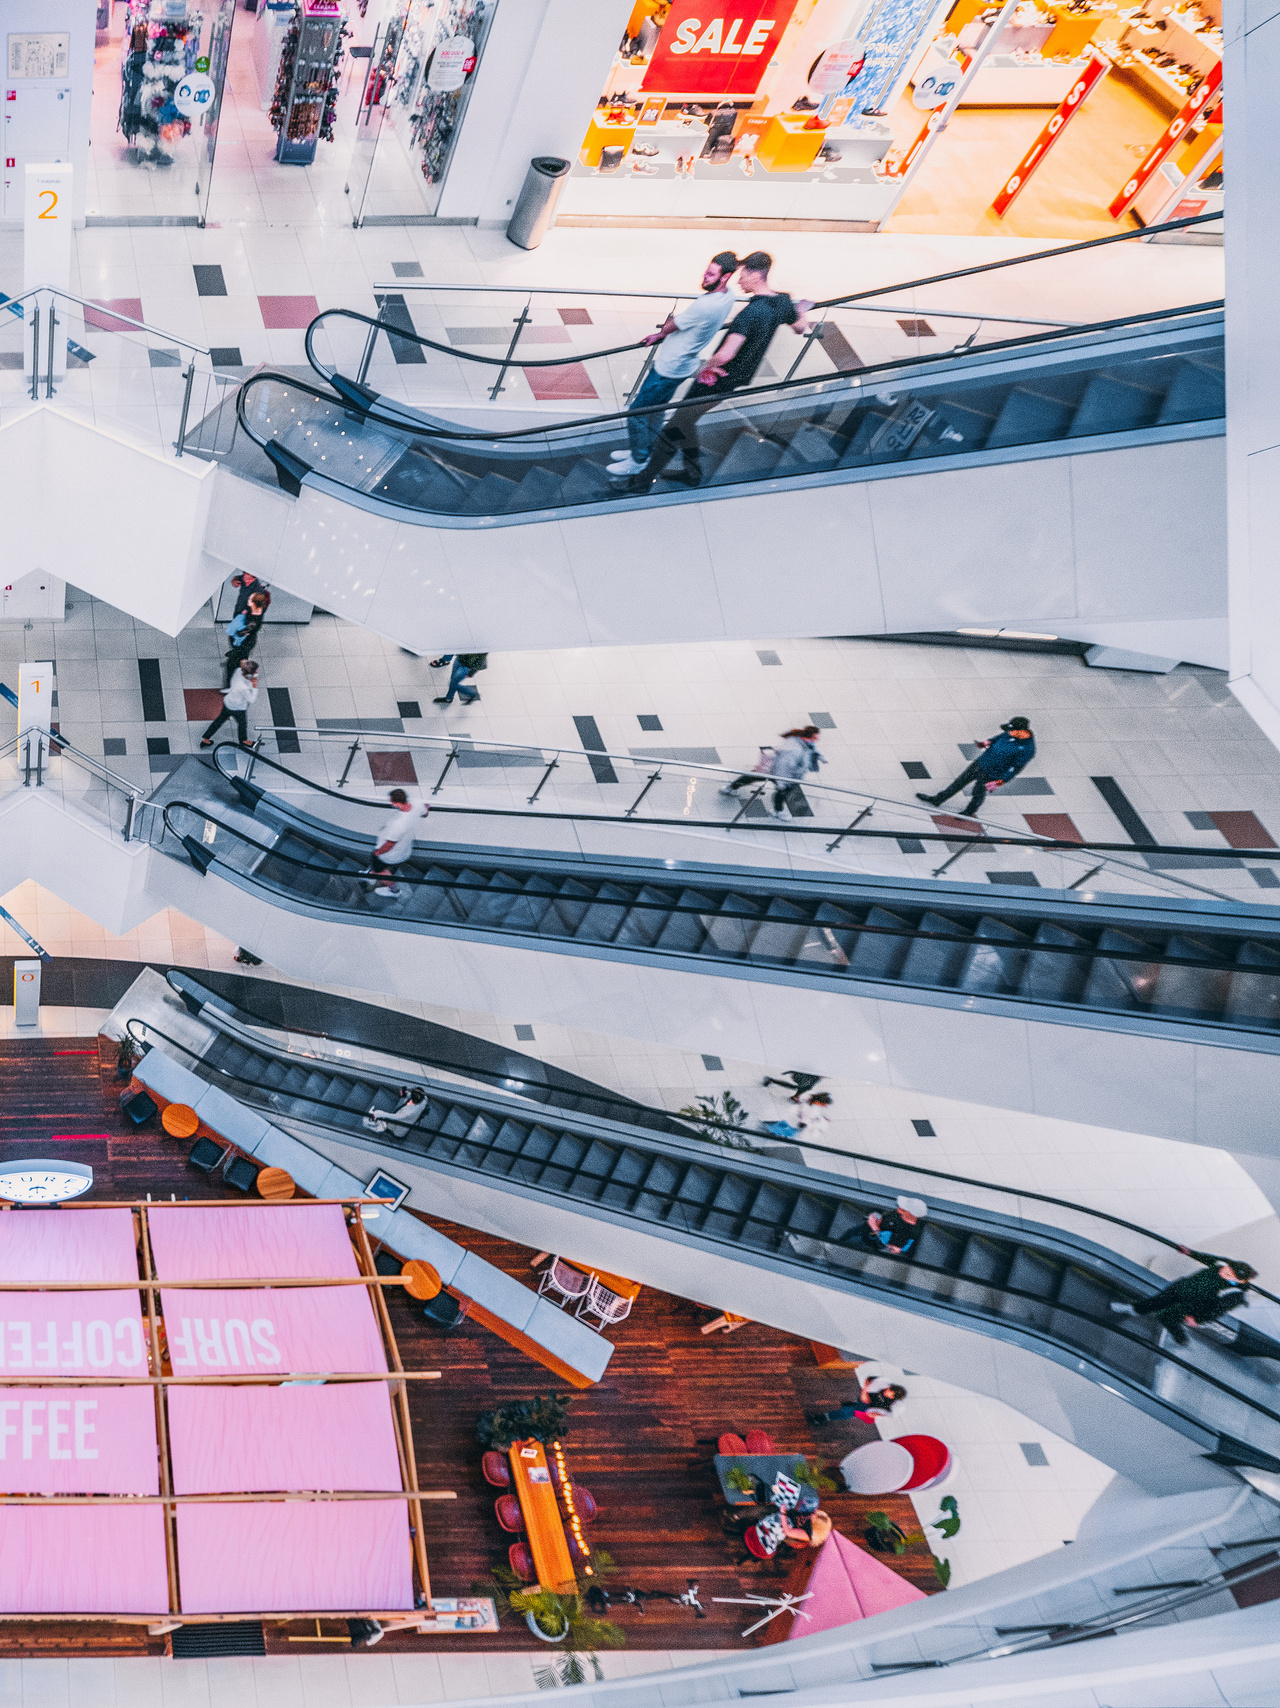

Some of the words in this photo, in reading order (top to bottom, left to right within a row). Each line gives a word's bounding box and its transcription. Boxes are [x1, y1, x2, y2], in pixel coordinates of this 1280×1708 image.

[670, 18, 776, 55] SALE
[38, 190, 58, 219] 2
[31, 680, 40, 694] 1
[173, 1318, 282, 1367] SURF
